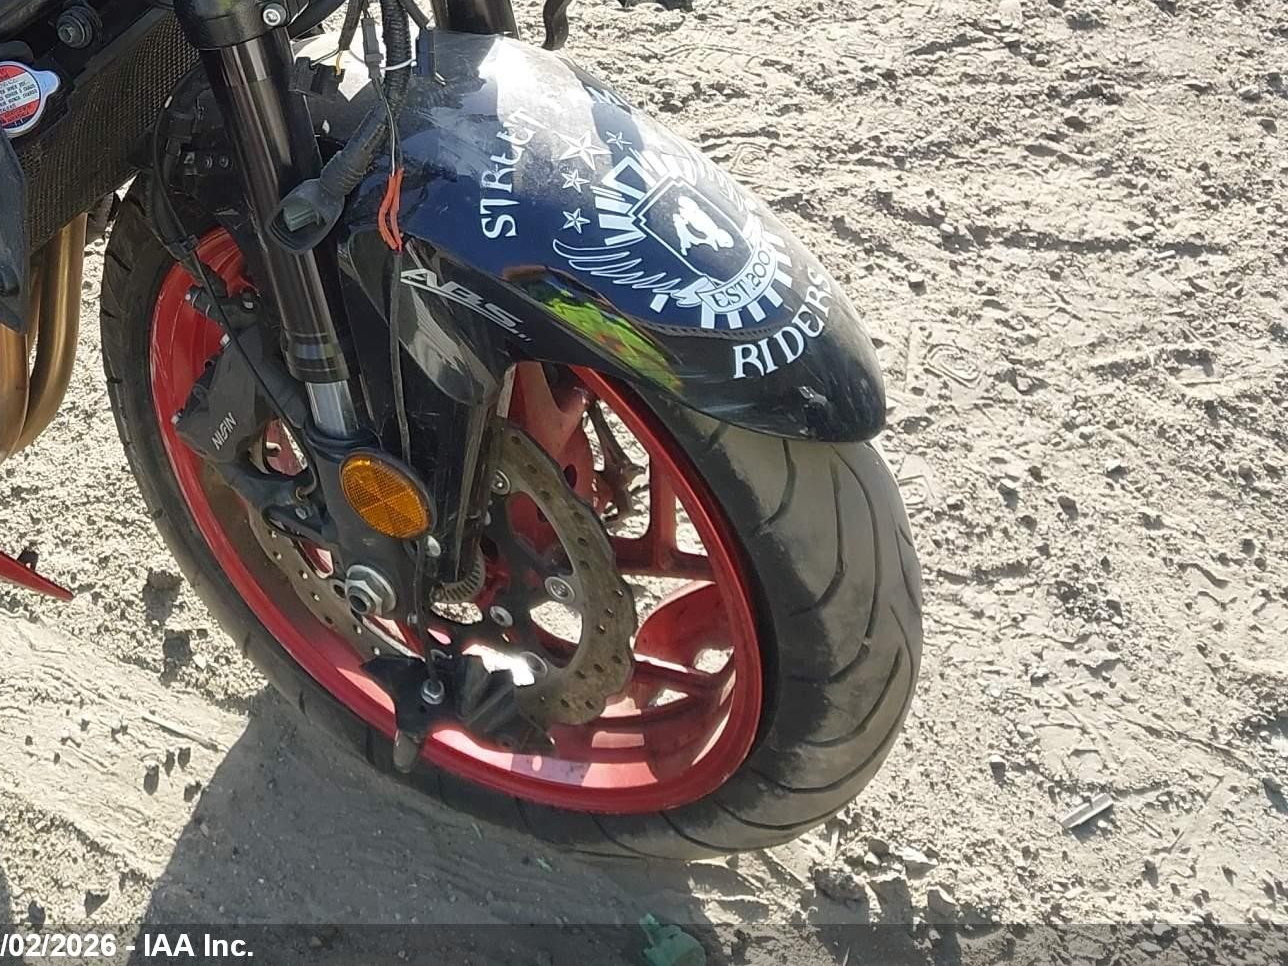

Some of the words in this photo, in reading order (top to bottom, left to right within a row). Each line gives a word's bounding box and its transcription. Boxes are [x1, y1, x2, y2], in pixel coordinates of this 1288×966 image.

[479, 106, 549, 239] STREET
[400, 268, 526, 334] ABS
[732, 266, 833, 379] RIDERS
